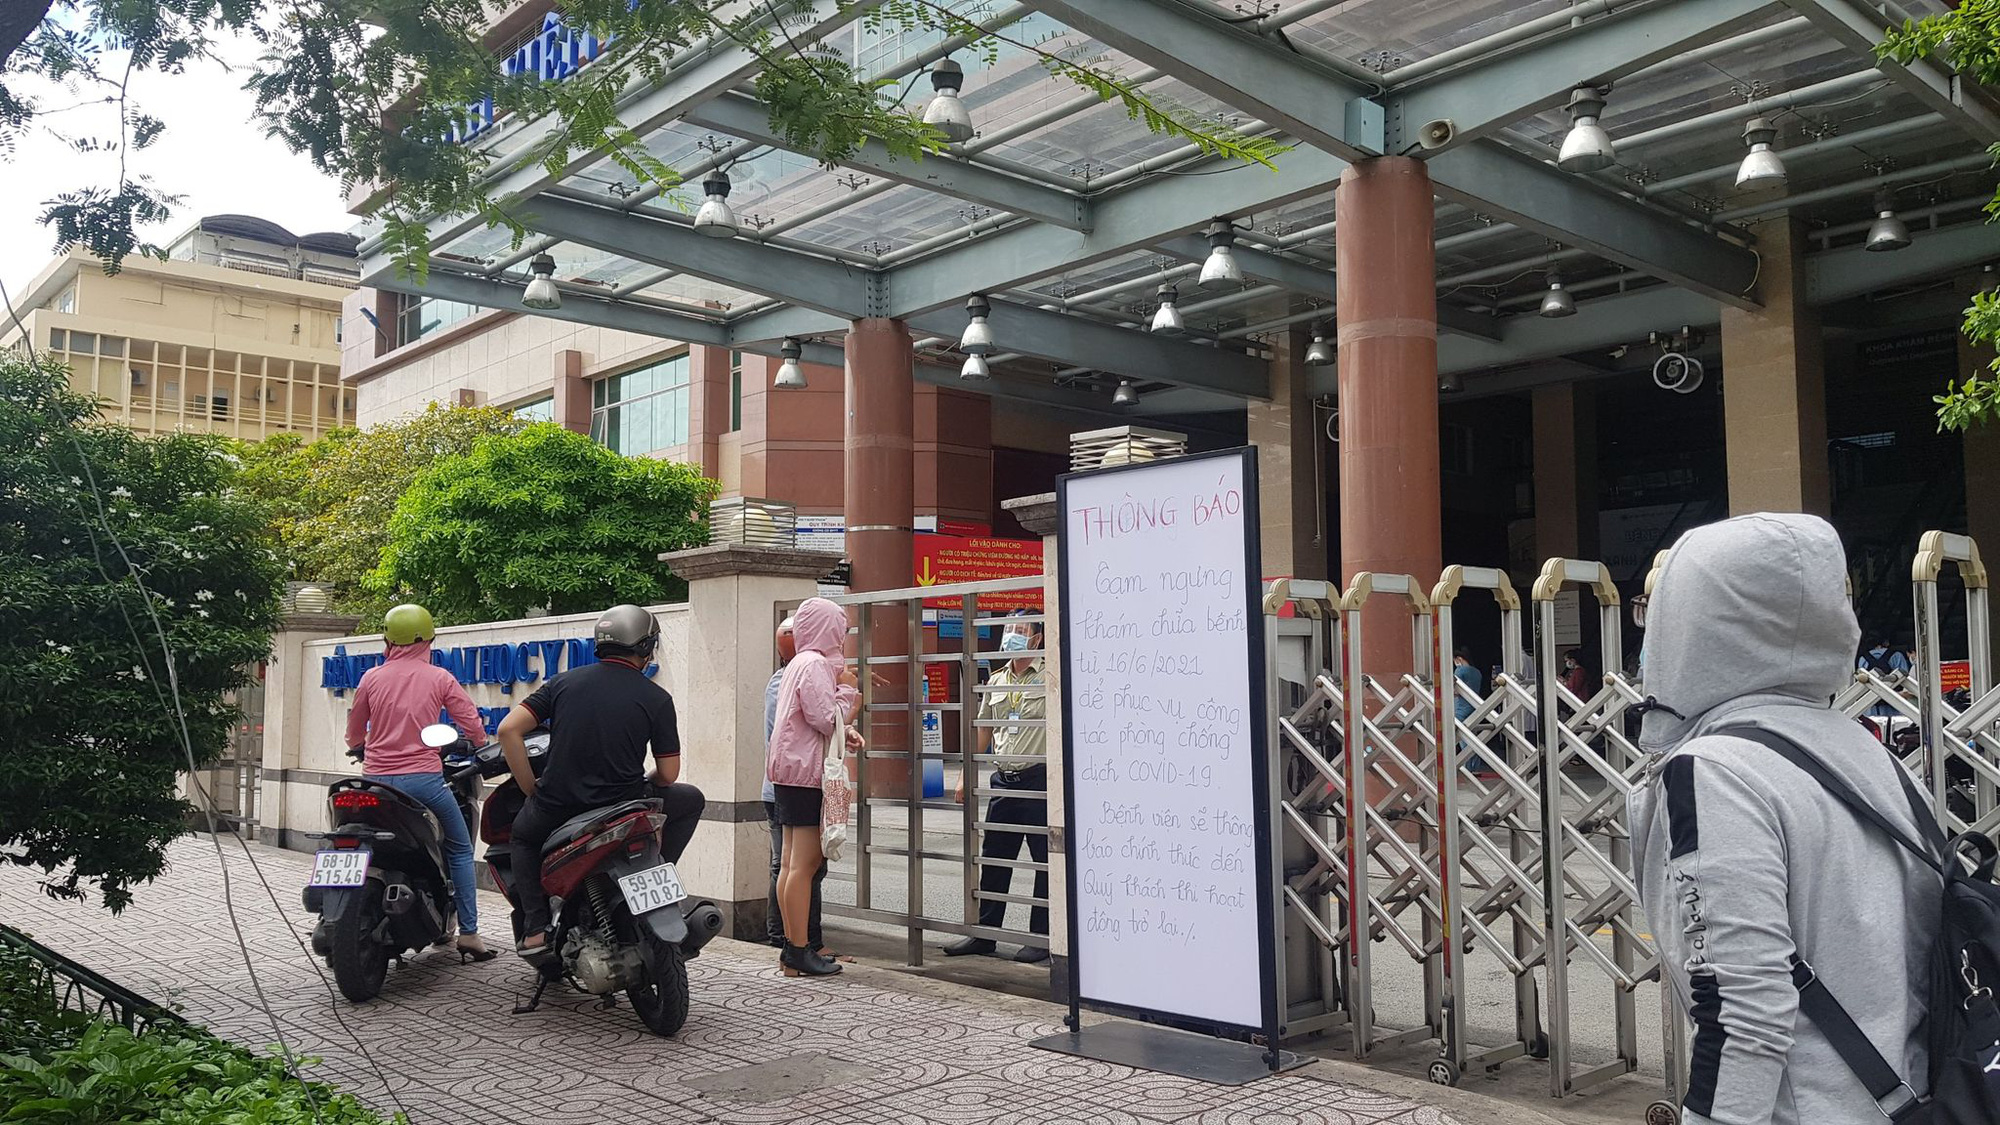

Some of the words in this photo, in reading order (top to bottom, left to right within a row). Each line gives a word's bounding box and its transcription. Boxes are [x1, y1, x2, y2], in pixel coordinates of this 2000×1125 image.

[1072, 492, 1178, 545] THÔNG
[1193, 474, 1240, 526] BÁO
[1076, 609, 1142, 639] khám
[1151, 607, 1196, 636] chữa
[1207, 606, 1246, 635] bệnh
[1076, 650, 1101, 674] từ
[1106, 648, 1203, 677] 16/6/2021
[1113, 683, 1152, 718] phục
[1157, 698, 1185, 724] vụ
[1197, 697, 1240, 735] công
[1080, 720, 1109, 744] tác
[1119, 721, 1165, 756] phòng
[1178, 721, 1233, 760] chống
[1081, 755, 1119, 786] dịch
[1099, 801, 1145, 828] Bệnh
[1152, 809, 1181, 832] viện
[1190, 806, 1208, 832] sẽ
[1213, 809, 1253, 847] thông
[322, 854, 360, 868] 68-D1
[1081, 828, 1113, 860] báo
[1121, 836, 1161, 861] chính
[1168, 844, 1201, 869] thức
[1210, 847, 1245, 873] đến
[314, 869, 362, 884] 515.46
[628, 868, 671, 893] 59-D2
[1084, 869, 1113, 906] Quý
[1121, 874, 1166, 900] khách
[1172, 879, 1198, 903] khi
[1204, 885, 1246, 912] hoạt
[630, 883, 683, 911] 170.82
[1087, 907, 1120, 942] động
[1128, 909, 1149, 935] trở
